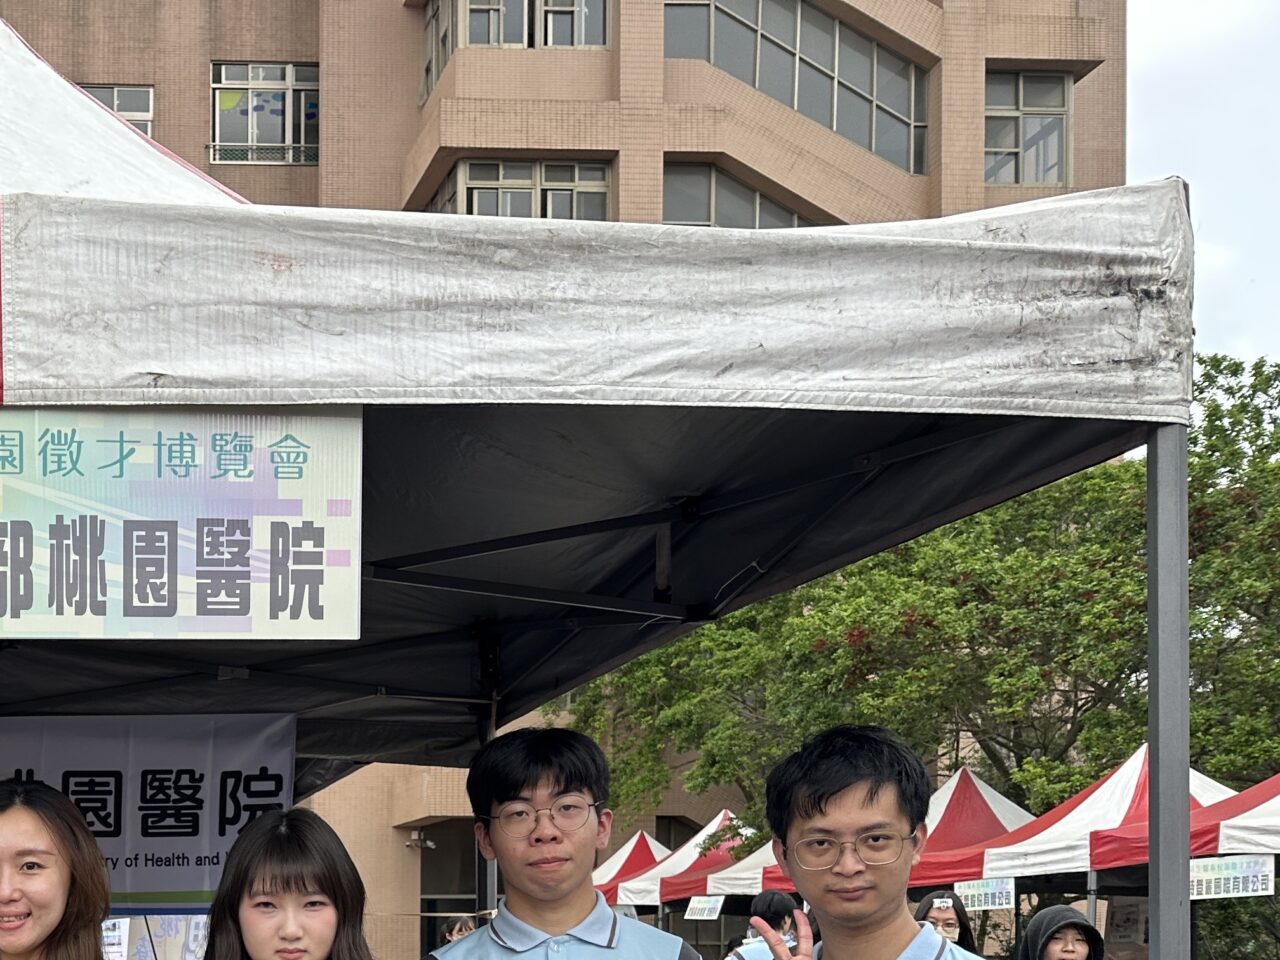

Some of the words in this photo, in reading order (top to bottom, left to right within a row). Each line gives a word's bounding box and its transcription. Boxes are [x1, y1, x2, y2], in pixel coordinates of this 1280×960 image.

[124, 853, 139, 868] of
[144, 852, 190, 867] Health
[195, 852, 220, 866] and
